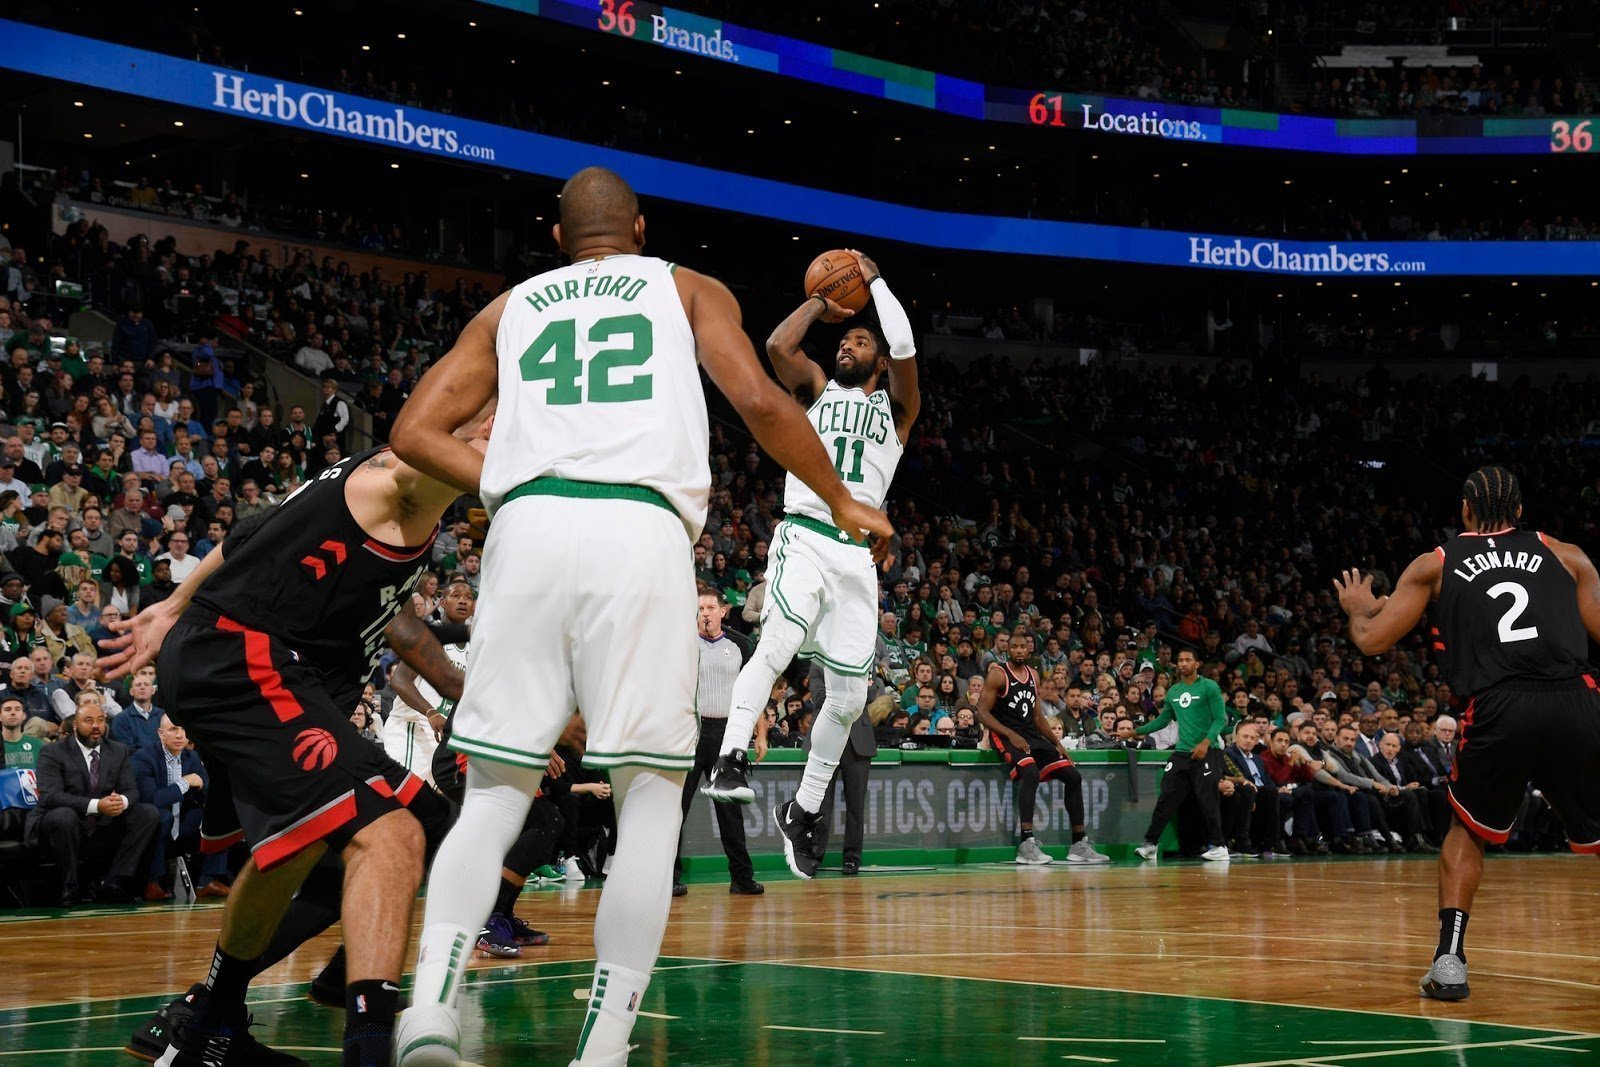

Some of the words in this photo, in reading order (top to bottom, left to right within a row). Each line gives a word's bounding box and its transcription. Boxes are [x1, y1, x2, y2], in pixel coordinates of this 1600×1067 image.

[598, 0, 636, 37] 36
[651, 14, 739, 62] Brands.
[212, 71, 496, 161] HerbChambers.com
[1029, 93, 1065, 127] 61
[1082, 104, 1207, 141] Locations.
[1550, 120, 1593, 153] 36
[1189, 237, 1426, 272] HerbChambers.com
[525, 275, 648, 313] HORFORD
[518, 313, 653, 405] 42
[818, 401, 890, 446] CELTICS
[833, 436, 865, 484] 11
[1453, 551, 1544, 583] LEONARD
[1486, 581, 1539, 643] 2
[1022, 703, 1029, 718] 9
